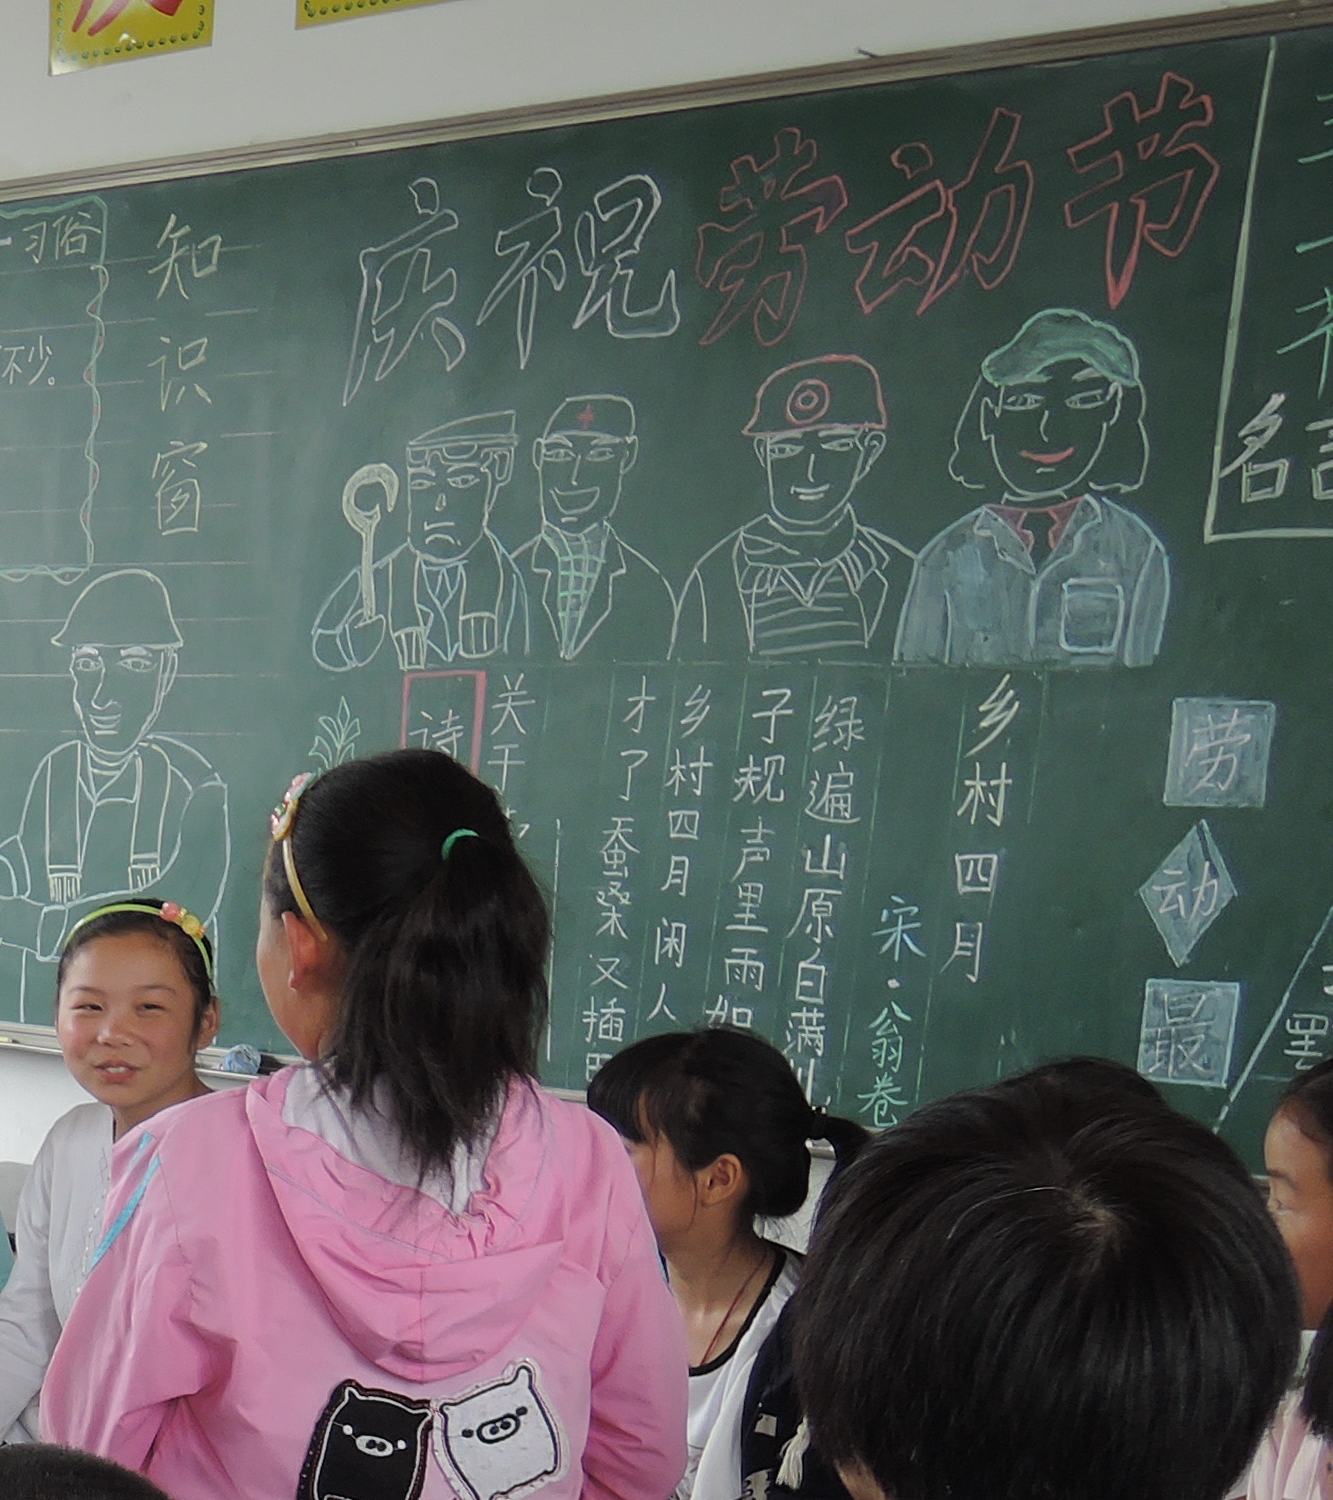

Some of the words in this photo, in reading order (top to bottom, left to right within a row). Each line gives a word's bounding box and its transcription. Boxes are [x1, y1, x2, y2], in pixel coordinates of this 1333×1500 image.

[148, 213, 222, 536] 知识窗
[940, 674, 1021, 983] 乡村四月
